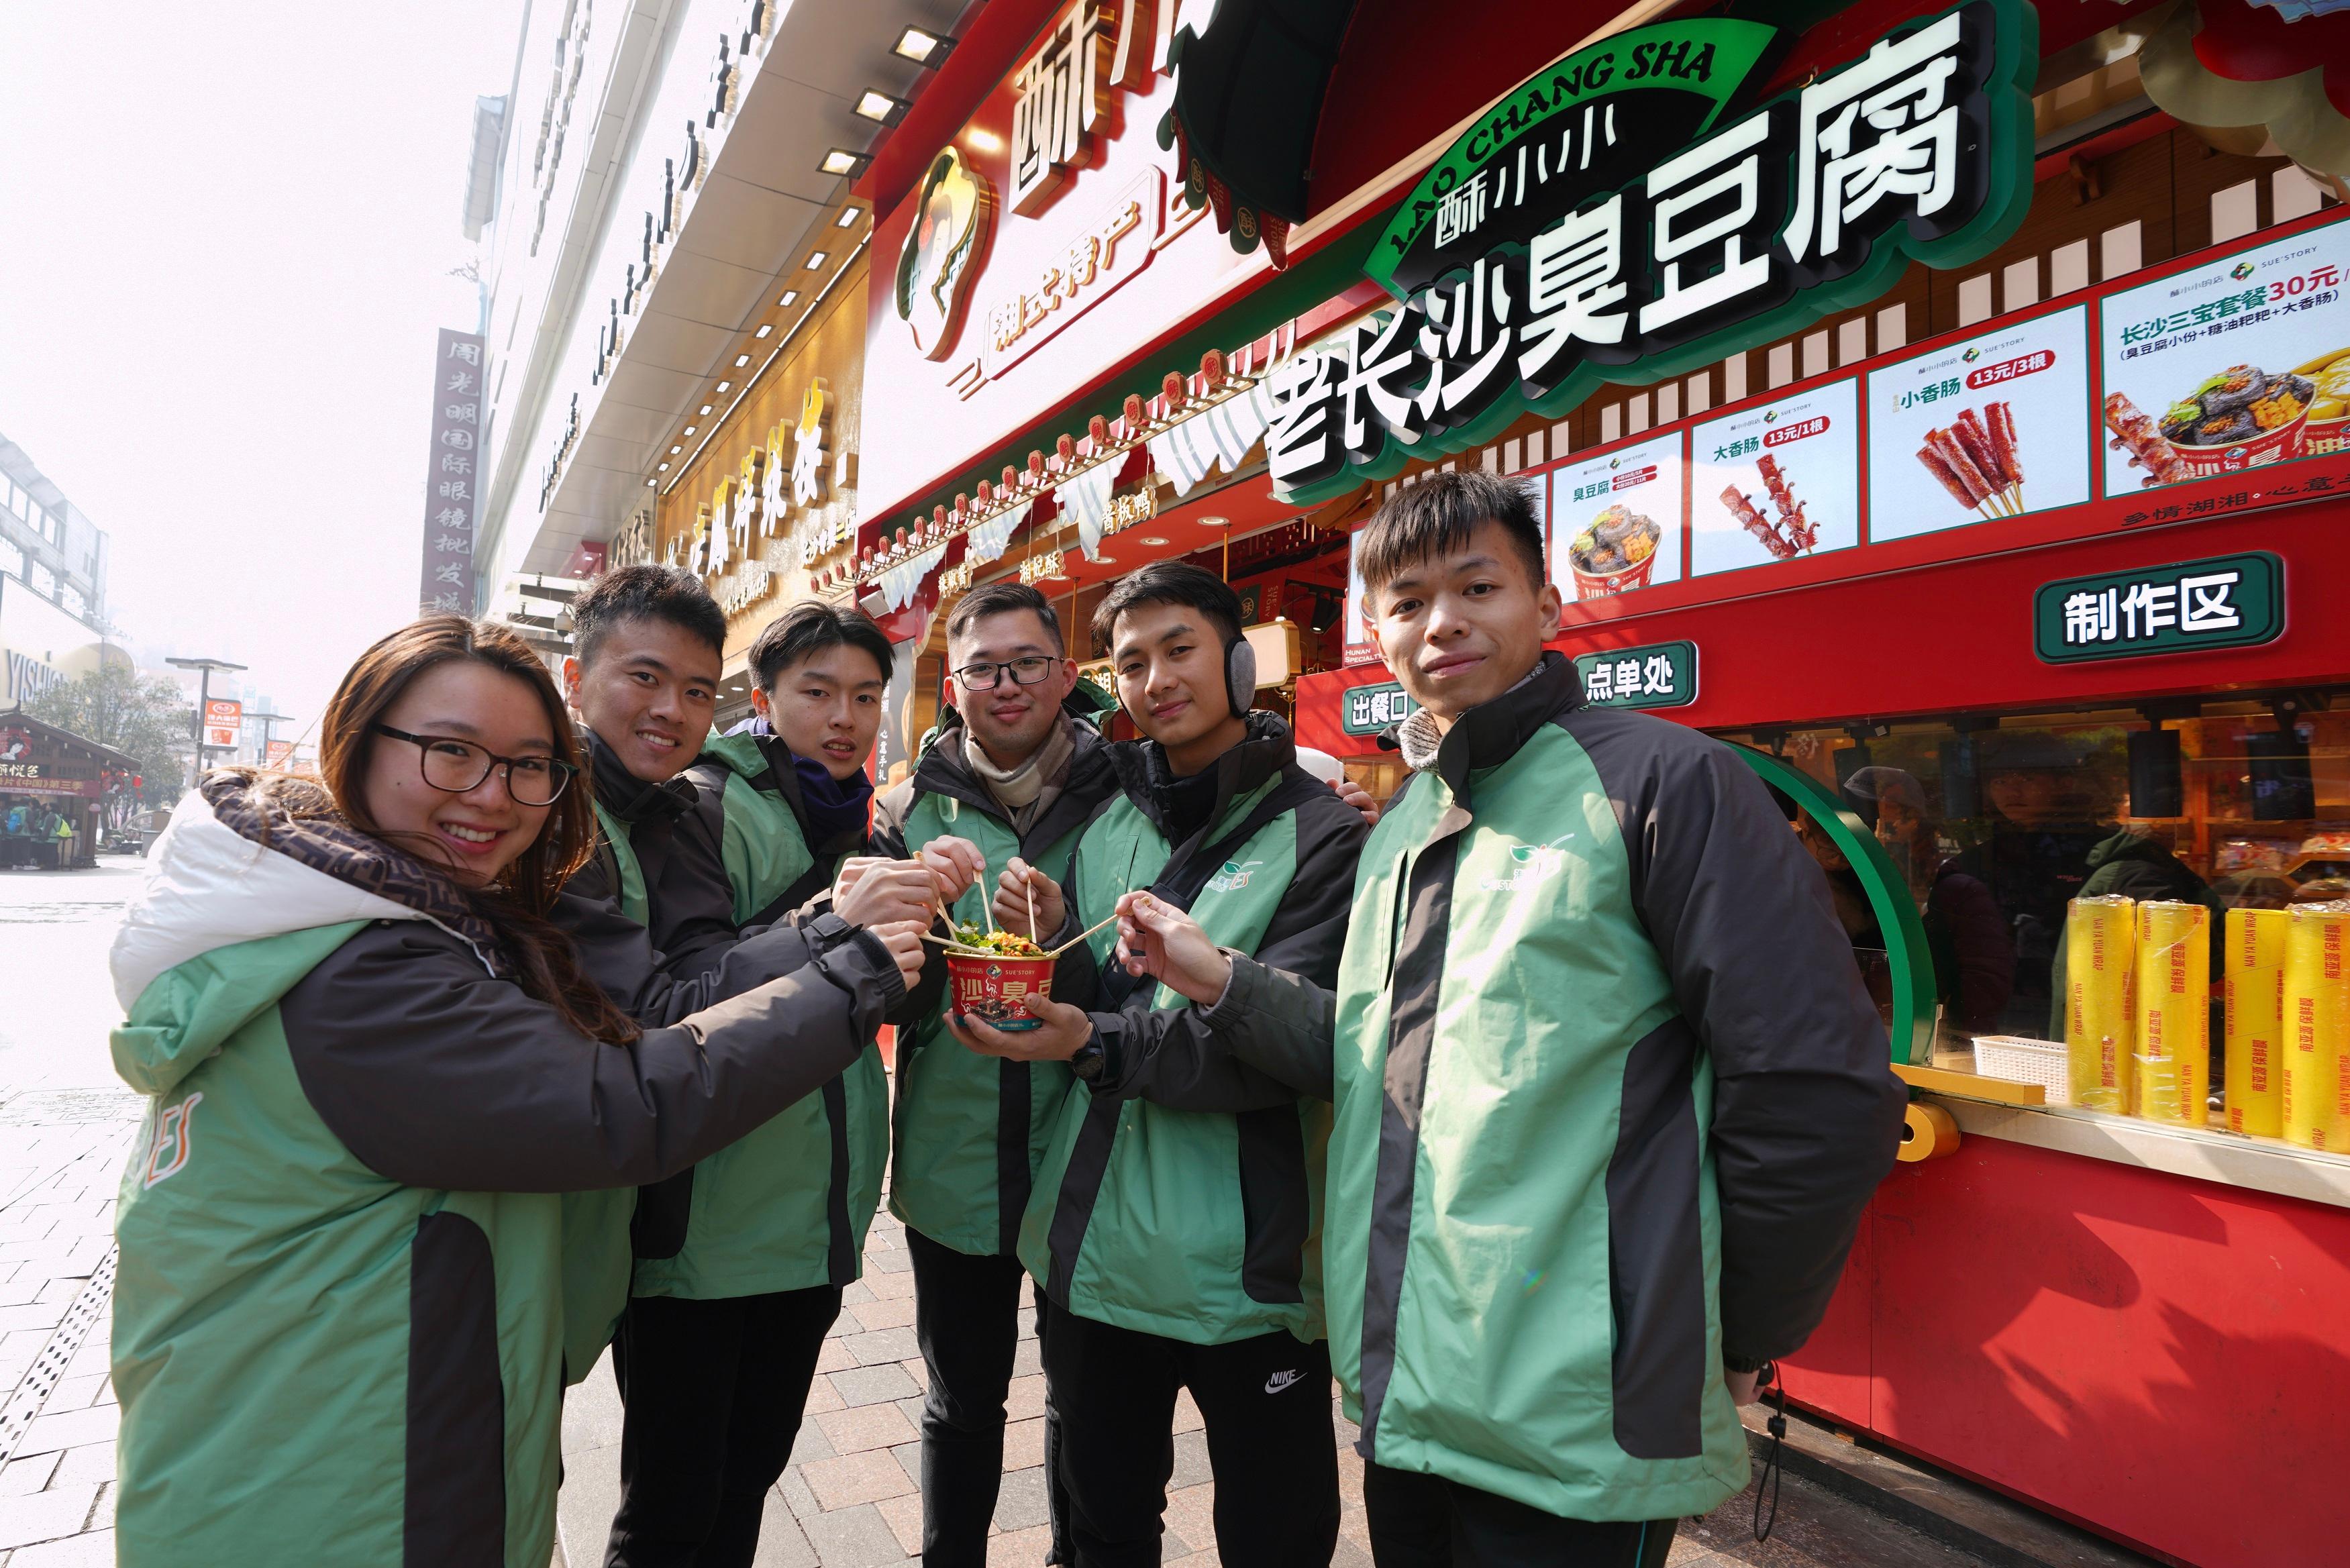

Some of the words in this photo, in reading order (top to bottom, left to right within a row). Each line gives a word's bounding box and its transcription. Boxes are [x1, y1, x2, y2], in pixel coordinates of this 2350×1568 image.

[1390, 166, 1458, 254] LAO
[1466, 52, 1615, 164] CHANG
[1625, 40, 1717, 83] SHA
[1435, 103, 1617, 249] 酥小小
[1264, 10, 1961, 479] 老长沙臭豆腐
[2261, 246, 2318, 268] SUE'STORY
[993, 201, 1139, 352] 湘式特产
[1984, 336, 2025, 354] SUE'STORY
[1974, 352, 2047, 386] 13元/3根
[1900, 377, 1961, 409] 小香肠
[1781, 403, 1812, 417] SUE'STORY
[1768, 418, 1824, 444] 13元/1根
[1713, 435, 1759, 462] 大香肠
[436, 340, 482, 614] 周光明国际眼镜批发城
[1573, 480, 1610, 503] 臭豆腐
[2121, 492, 2248, 527] 多情湖湘
[1265, 586, 1274, 618] STORY
[2063, 572, 2240, 644] 制作区
[1345, 648, 1371, 656] HUNAN
[1586, 655, 1674, 702] 点单处
[1351, 690, 1409, 726] 出餐口
[2093, 918, 2104, 929] NAN
[2244, 911, 2257, 928] WRAP
[2143, 925, 2152, 941] WRAP
[2244, 929, 2257, 945] YUAN
[2324, 924, 2342, 951] 保鲜膜
[2093, 939, 2104, 954] YUAN
[2169, 942, 2186, 968] 南亚源
[2093, 955, 2104, 971] WRAP
[2244, 955, 2257, 968] NAN
[2324, 952, 2342, 980] 南亚源
[2074, 982, 2084, 994] NAN
[2169, 968, 2186, 994] 保鲜膜
[2074, 1004, 2084, 1018] YUAN
[2148, 1010, 2162, 1035] 南亚源
[2228, 1014, 2235, 1022] YA
[2299, 997, 2315, 1024] 保鲜膜
[2074, 1019, 2084, 1036] WRAP
[2299, 1025, 2315, 1053] 南亚源
[2251, 1039, 2268, 1065] 保鲜膜
[2101, 1063, 2115, 1087] 保鲜膜
[2180, 1064, 2192, 1077] NAN
[2251, 1065, 2268, 1092] 南亚源
[2180, 1087, 2192, 1102] YUAN
[2180, 1103, 2192, 1120] WRAP
[2312, 1128, 2326, 1147] WRAP
[1270, 1369, 1296, 1385] NIKE
